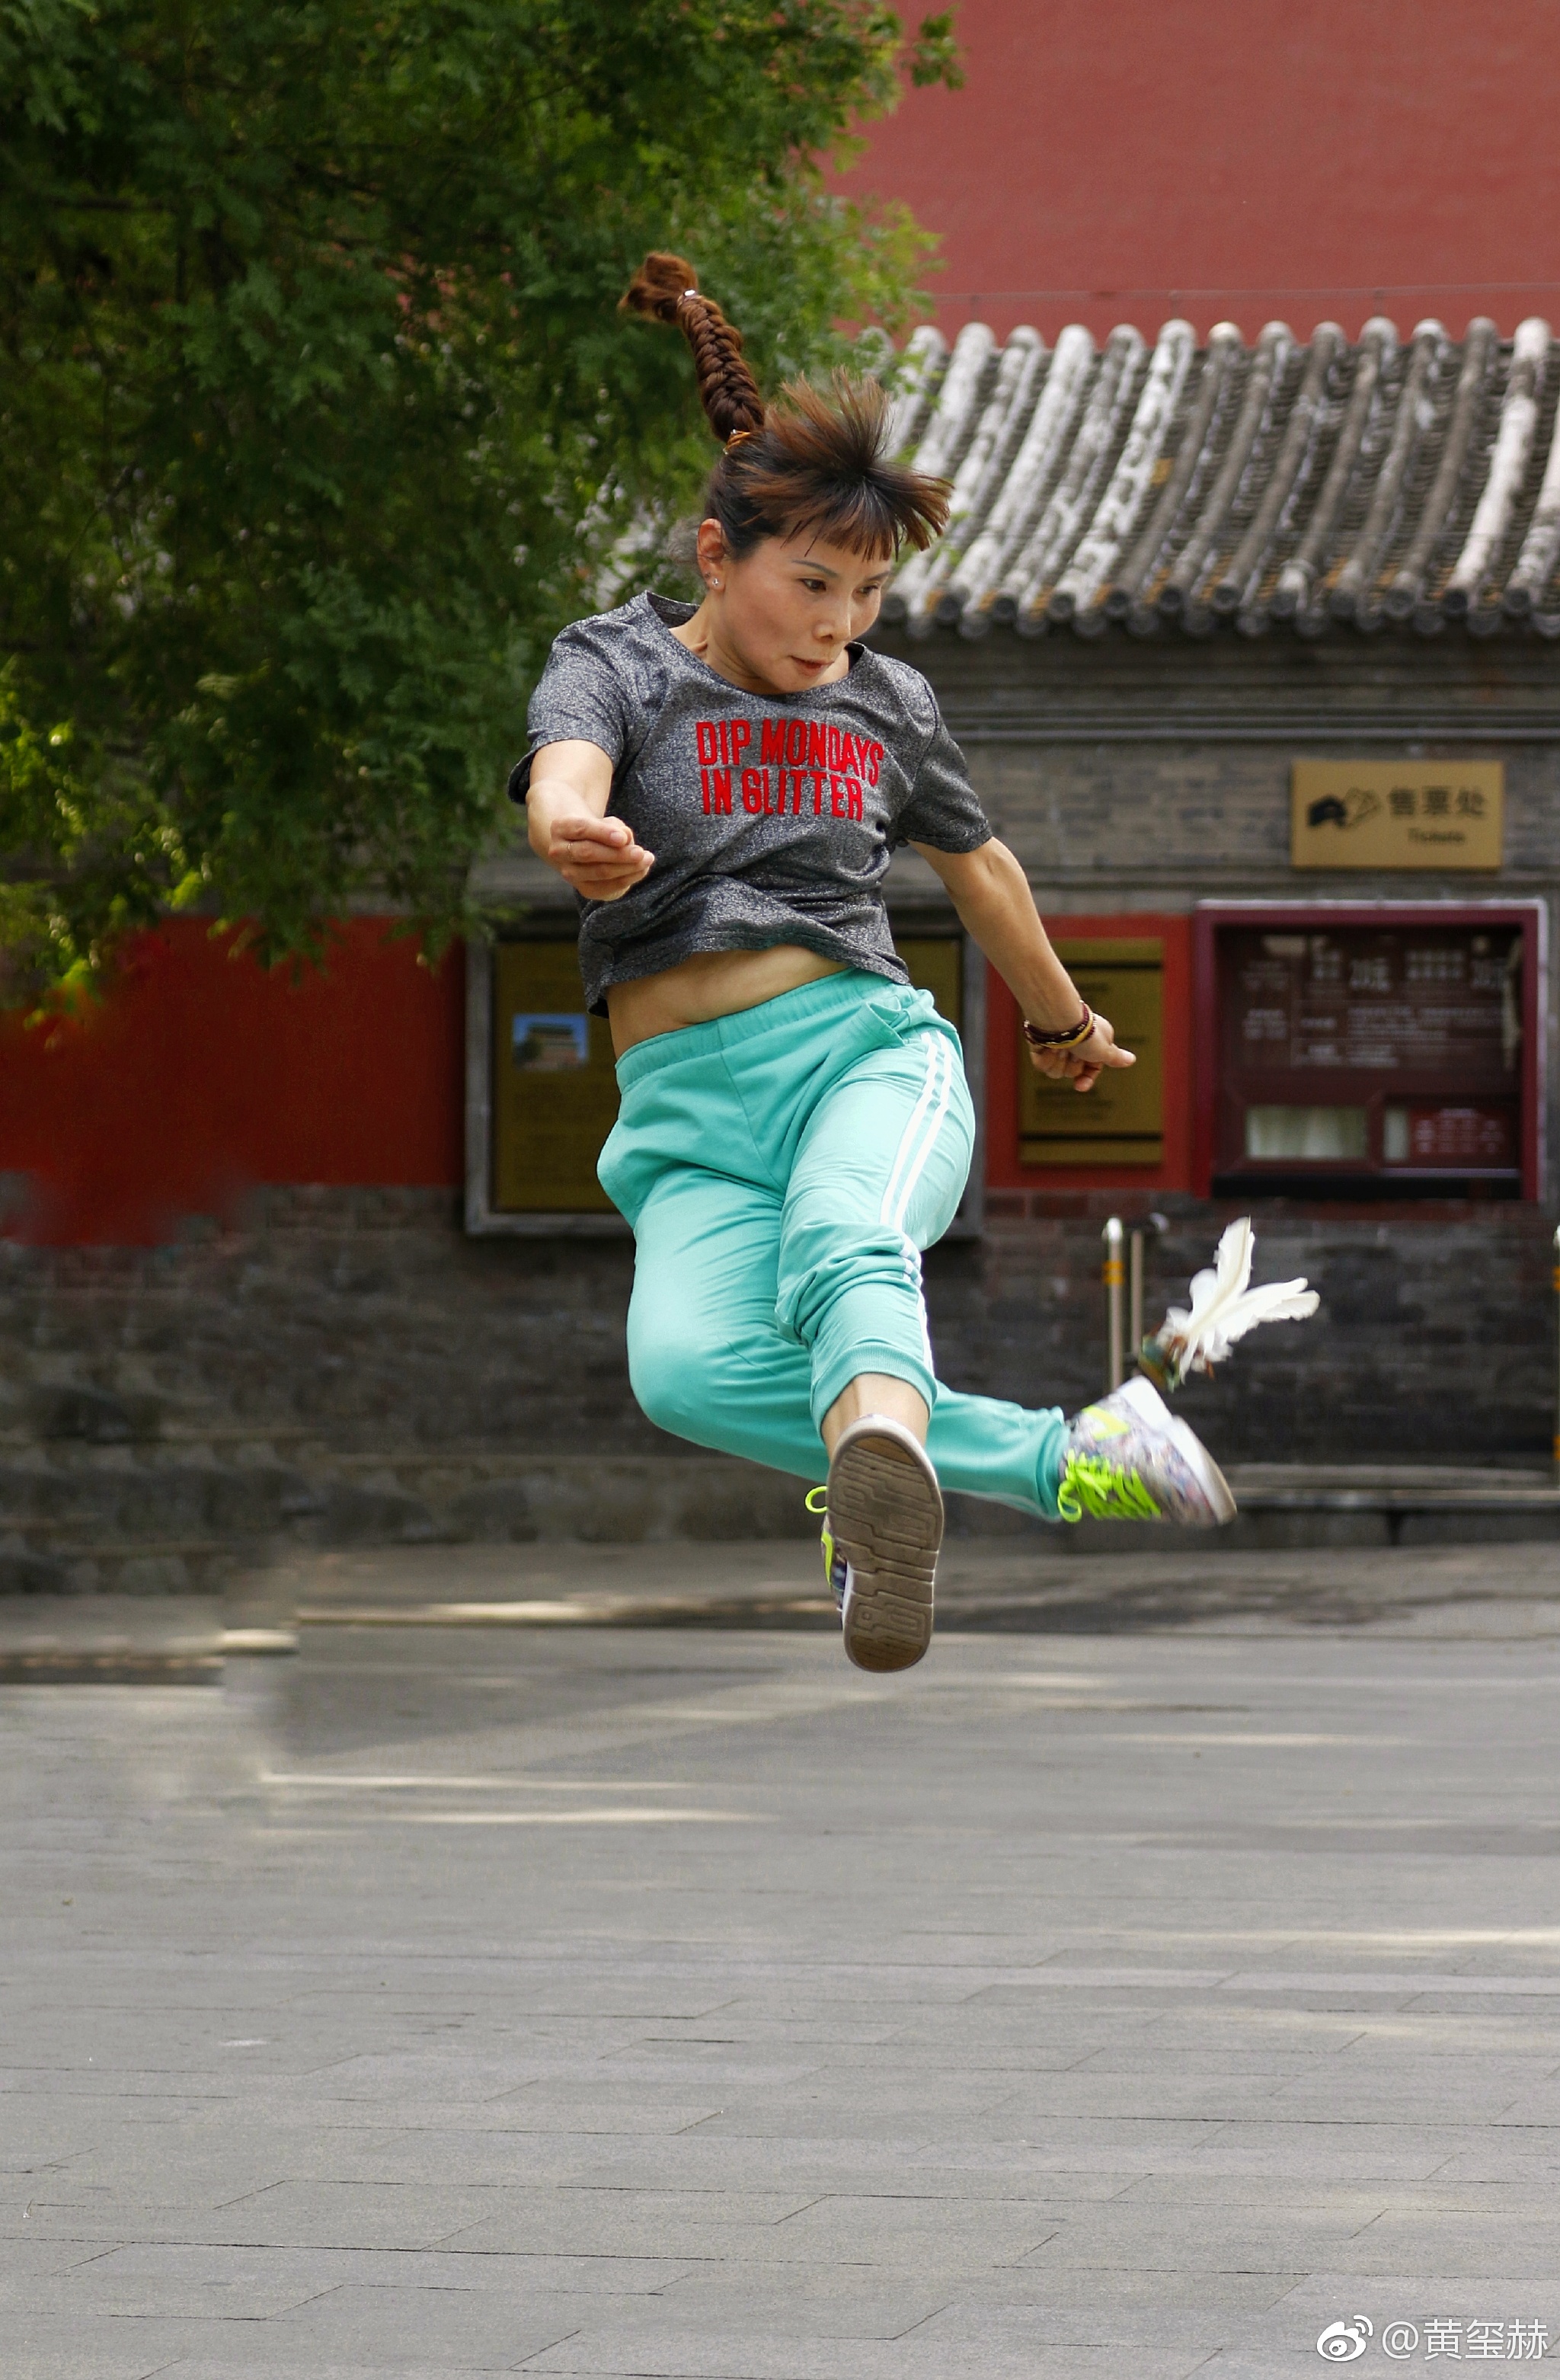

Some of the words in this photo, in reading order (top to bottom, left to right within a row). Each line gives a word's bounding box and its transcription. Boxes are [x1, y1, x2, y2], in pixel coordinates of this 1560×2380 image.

[696, 718, 751, 766] DIP
[759, 718, 884, 786] MONDAYS
[700, 768, 732, 815] IN
[741, 768, 863, 822] GLITTER
